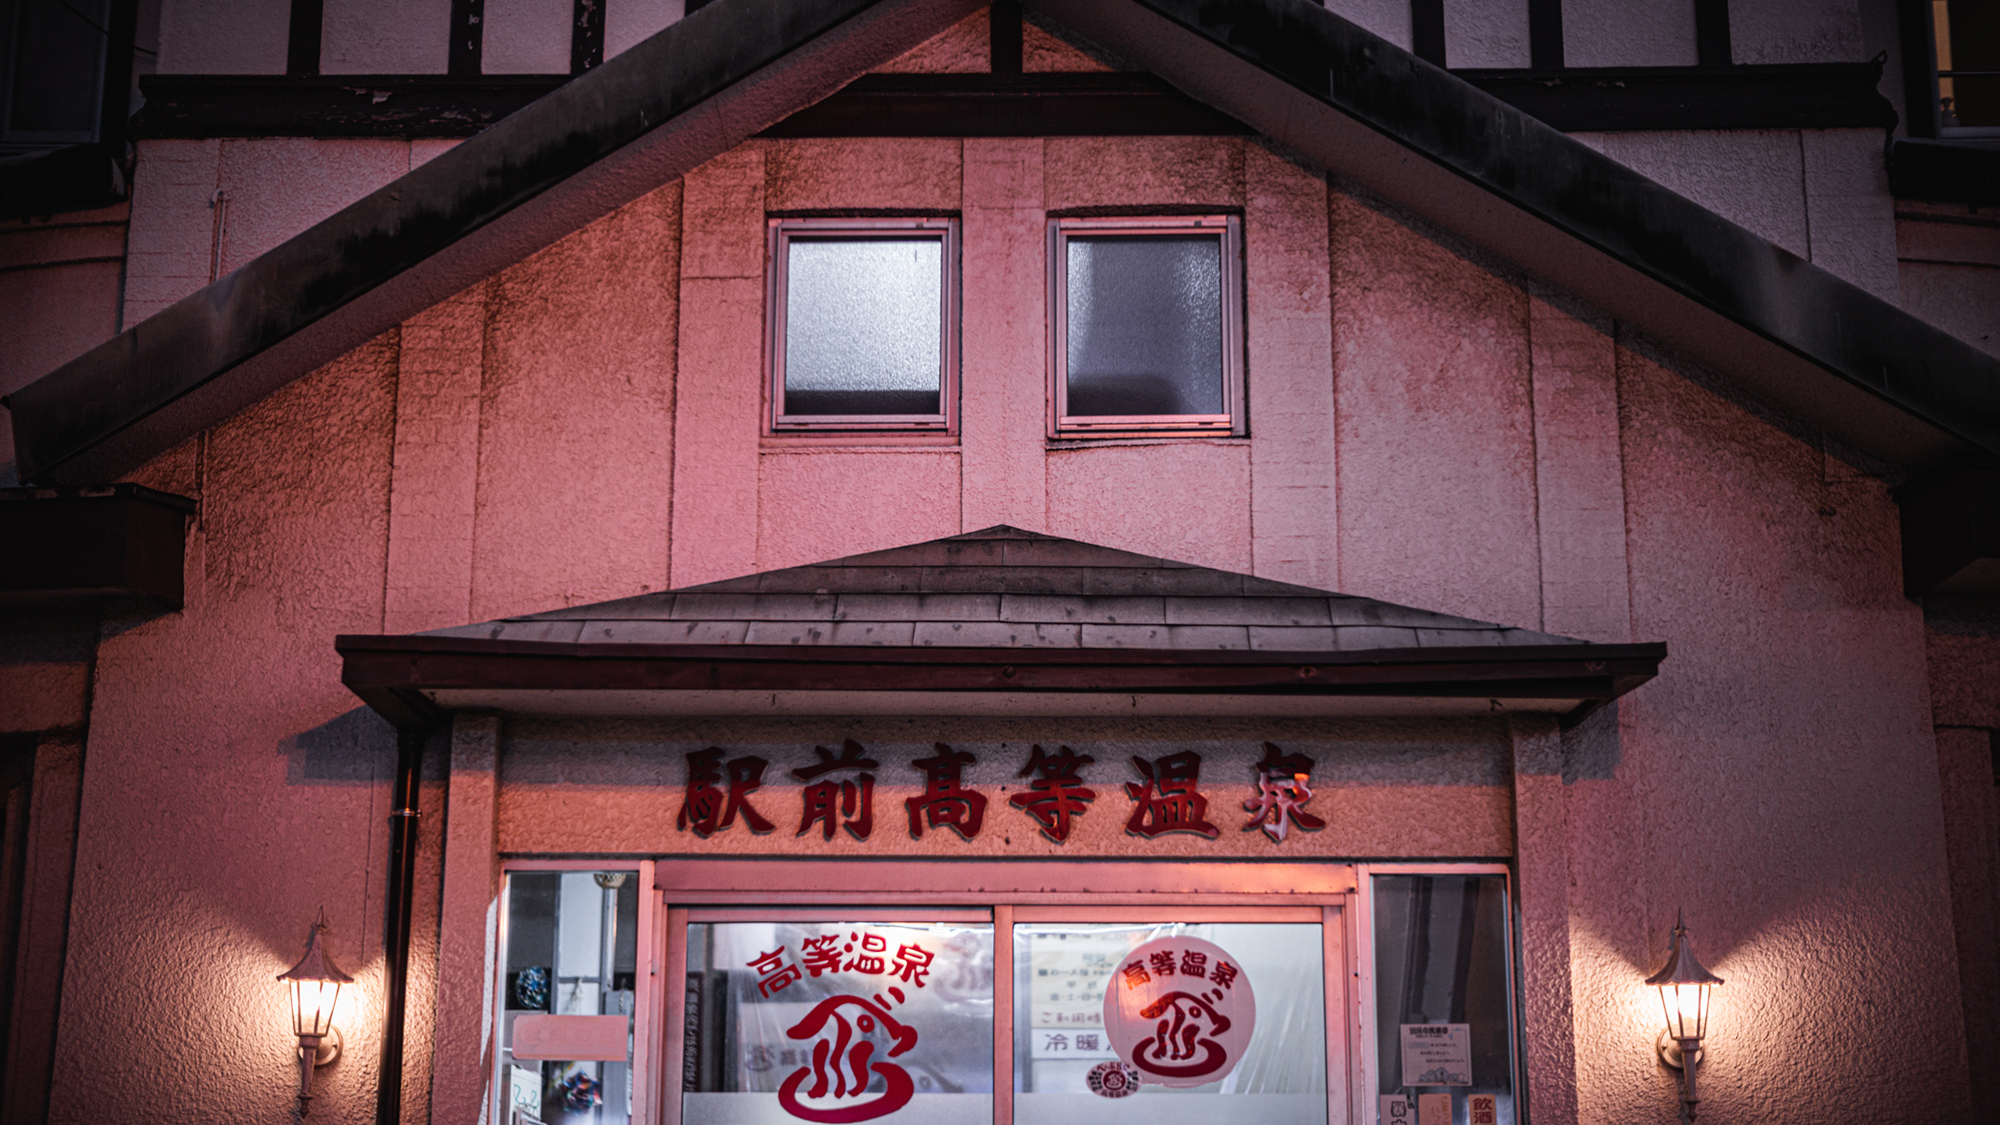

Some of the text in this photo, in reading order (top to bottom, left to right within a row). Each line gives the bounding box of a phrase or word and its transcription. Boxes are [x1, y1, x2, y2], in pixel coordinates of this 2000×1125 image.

[746, 931, 935, 999] 高等温泉
[1122, 949, 1239, 990] 高等温泉
[1044, 1033, 1114, 1051] 冷暖
[1473, 1097, 1492, 1124] 飲酒
